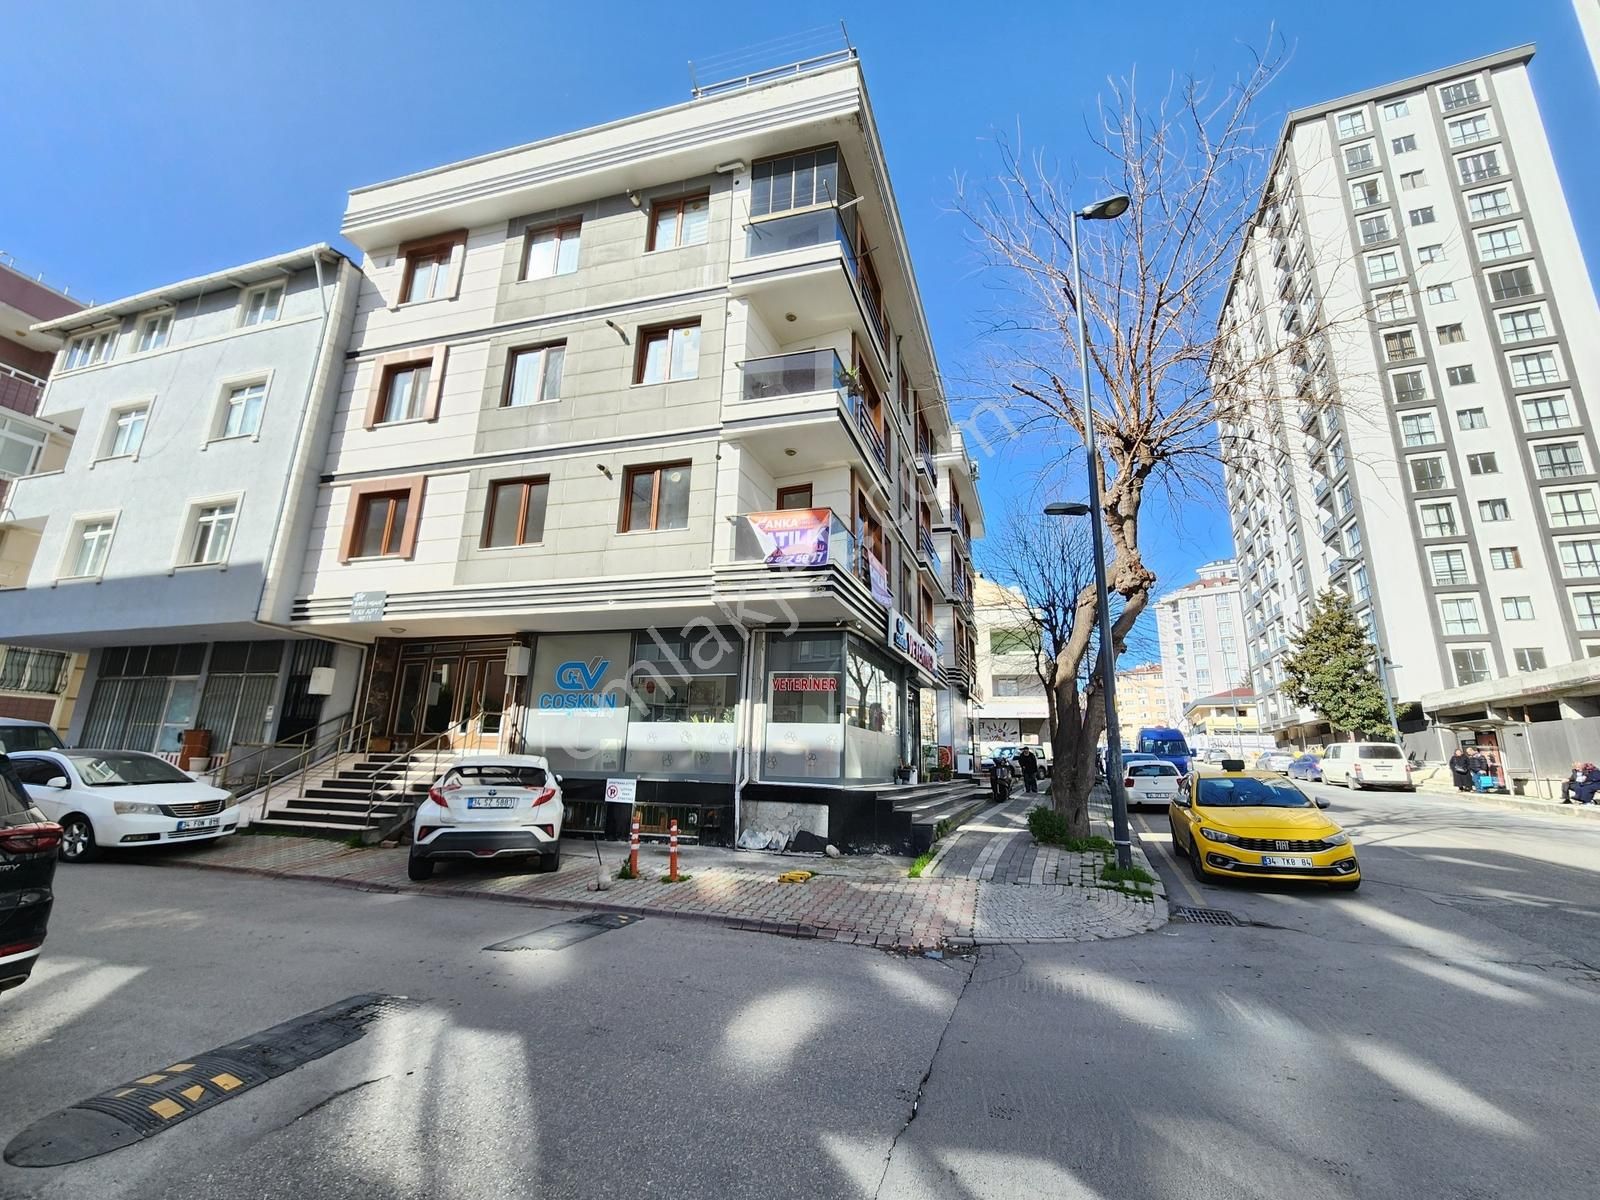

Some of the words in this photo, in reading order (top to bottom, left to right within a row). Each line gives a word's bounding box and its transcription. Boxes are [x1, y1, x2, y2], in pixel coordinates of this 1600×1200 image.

[766, 519, 799, 528] ANKA
[772, 674, 838, 692] VETERİNER
[1276, 841, 1290, 850] FIAT
